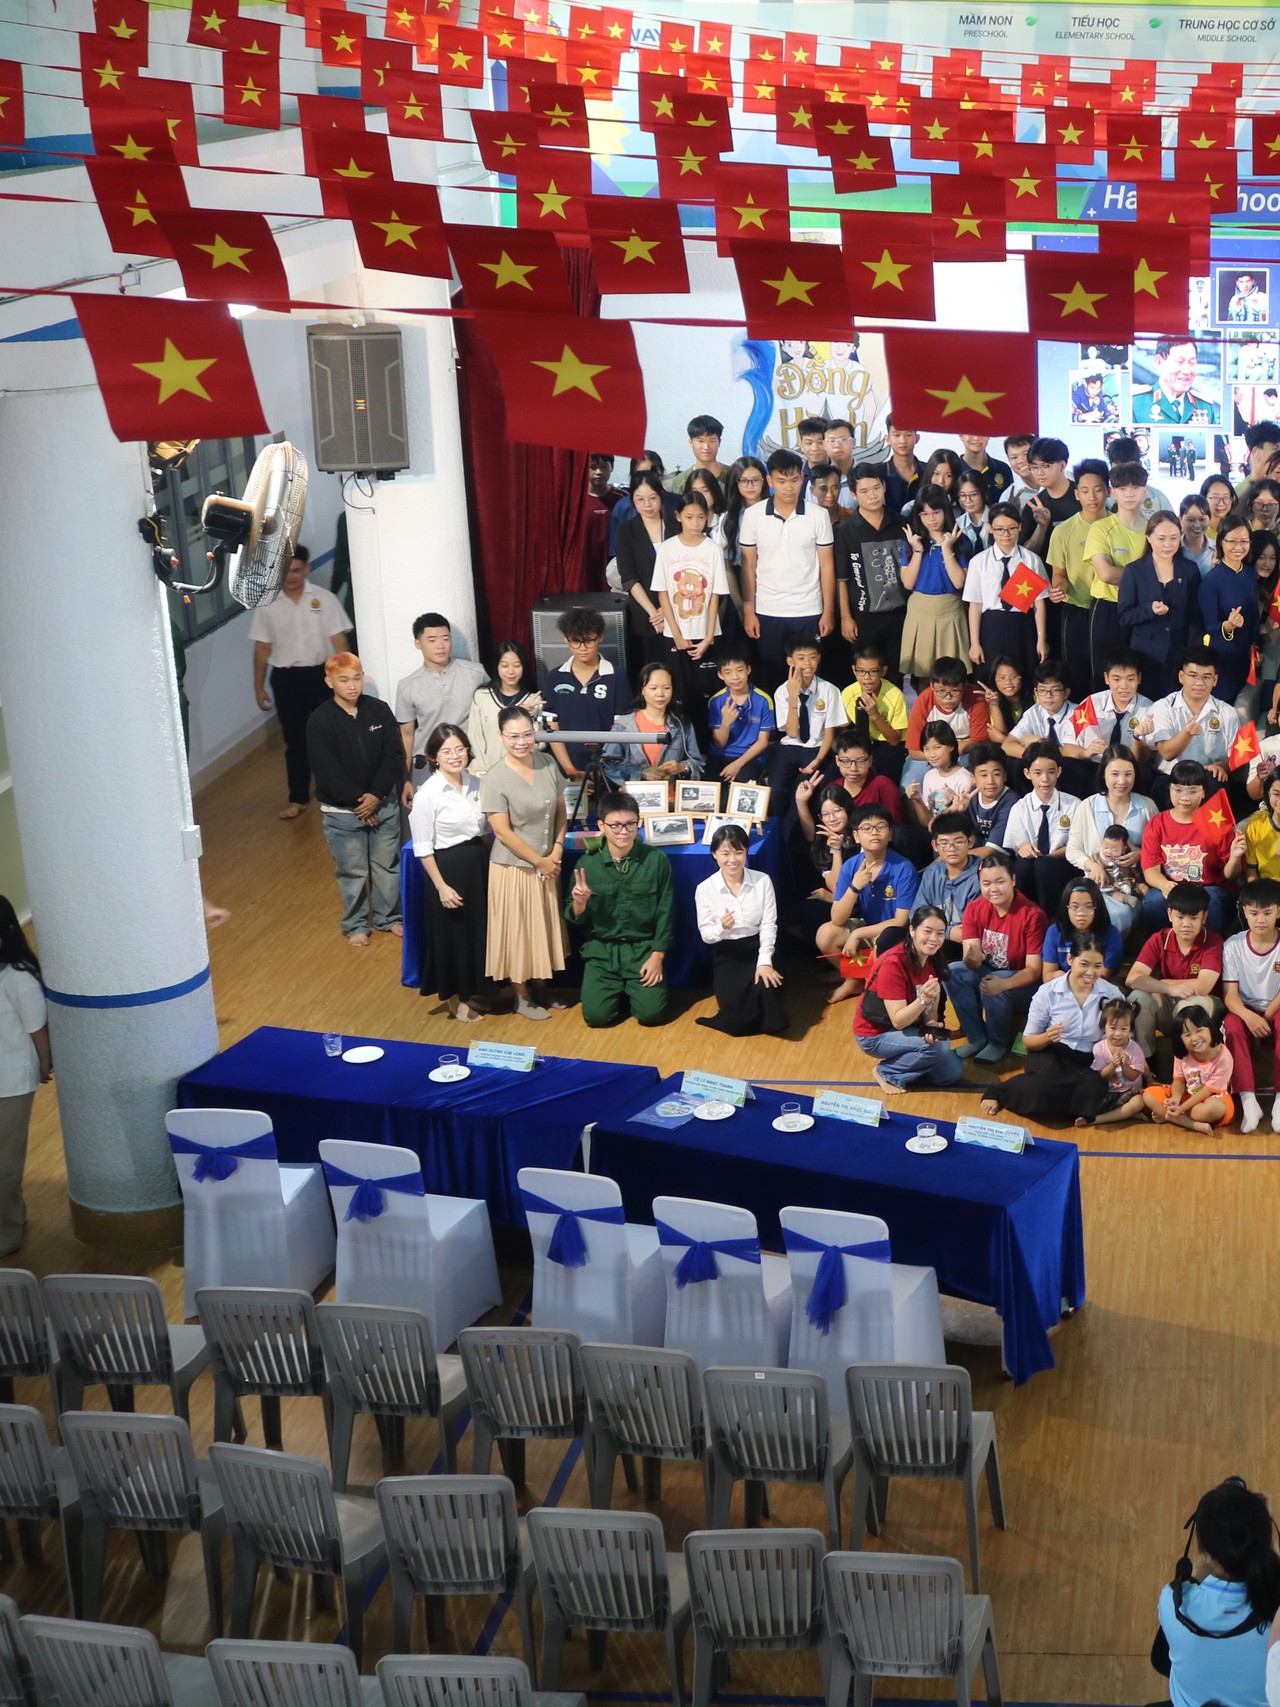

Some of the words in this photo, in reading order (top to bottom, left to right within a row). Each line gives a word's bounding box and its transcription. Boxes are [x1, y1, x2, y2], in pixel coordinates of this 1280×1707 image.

[958, 13, 987, 25] MẦM
[988, 15, 1013, 26] NON
[1097, 17, 1120, 29] HỌC
[1179, 19, 1216, 30] TRUNG
[1217, 20, 1241, 32] HỌC
[1242, 20, 1260, 30] CƠ
[1260, 17, 1276, 31] SỞ
[963, 30, 1008, 38] PRESCHOOL
[1055, 31, 1104, 40] ELEMENTARY
[1105, 32, 1136, 41] SCHOOL
[1197, 34, 1225, 42] MIDDLE
[1226, 35, 1257, 43] SCHOOL
[776, 346, 870, 411] Đồng
[594, 684, 607, 699] S
